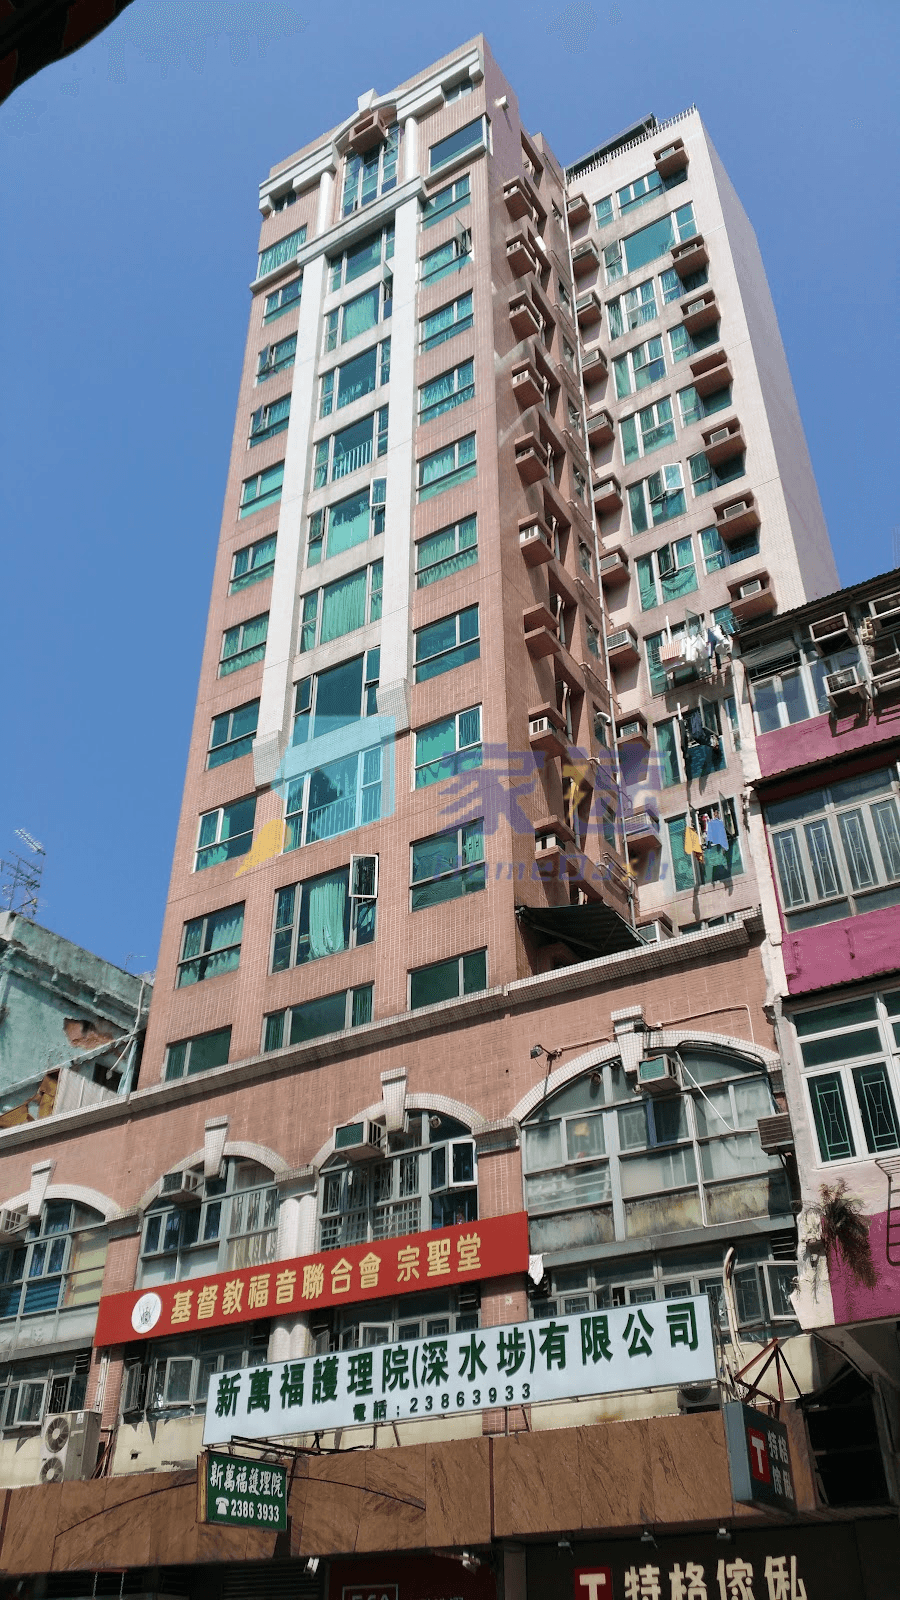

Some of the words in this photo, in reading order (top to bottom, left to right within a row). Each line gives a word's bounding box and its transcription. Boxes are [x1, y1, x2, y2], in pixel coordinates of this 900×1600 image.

[396, 1232, 482, 1282] 宗聖堂
[210, 1461, 283, 1498] 新萬福護理院
[230, 1499, 255, 1519] 2386
[256, 1502, 280, 1522] 3933
